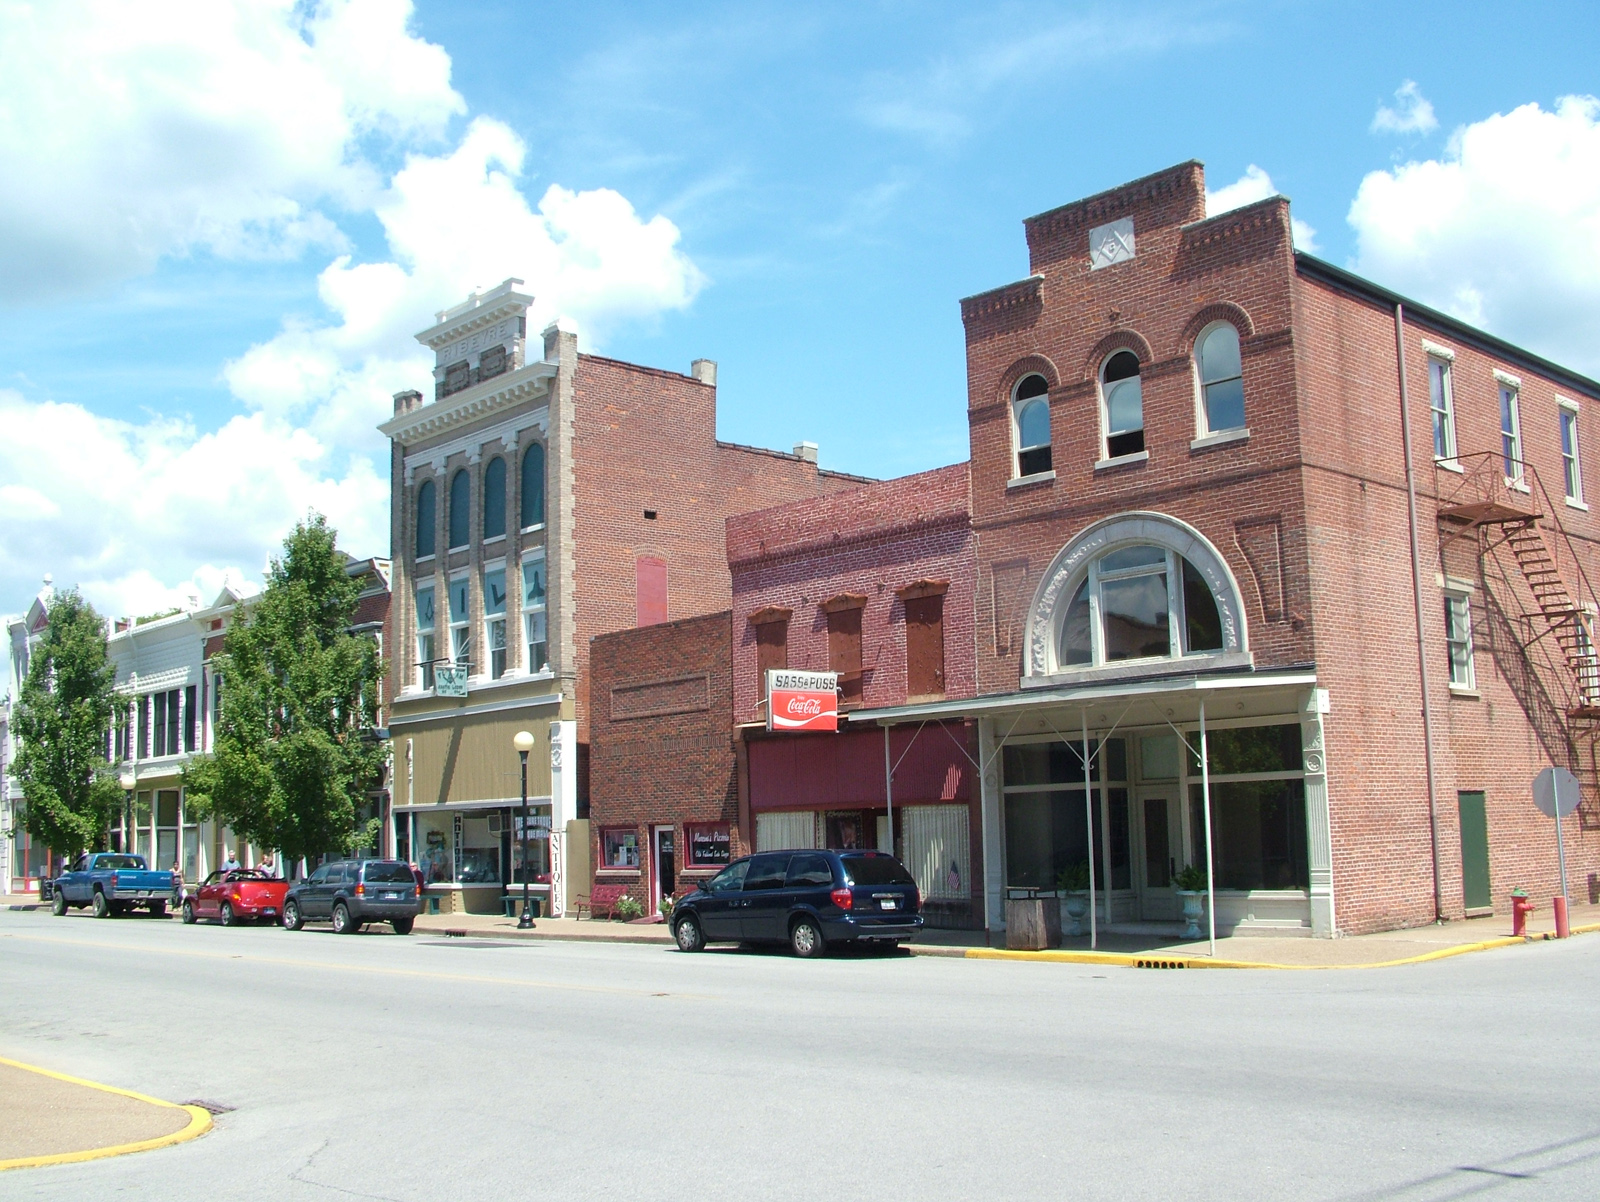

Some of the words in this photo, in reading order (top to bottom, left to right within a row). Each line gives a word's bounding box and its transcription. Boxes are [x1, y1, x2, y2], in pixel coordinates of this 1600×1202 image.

[443, 323, 507, 361] RIBEYRE
[776, 675, 803, 689] SASS
[787, 698, 821, 714] Coca-Cola
[552, 834, 561, 913] ANTIQUES
